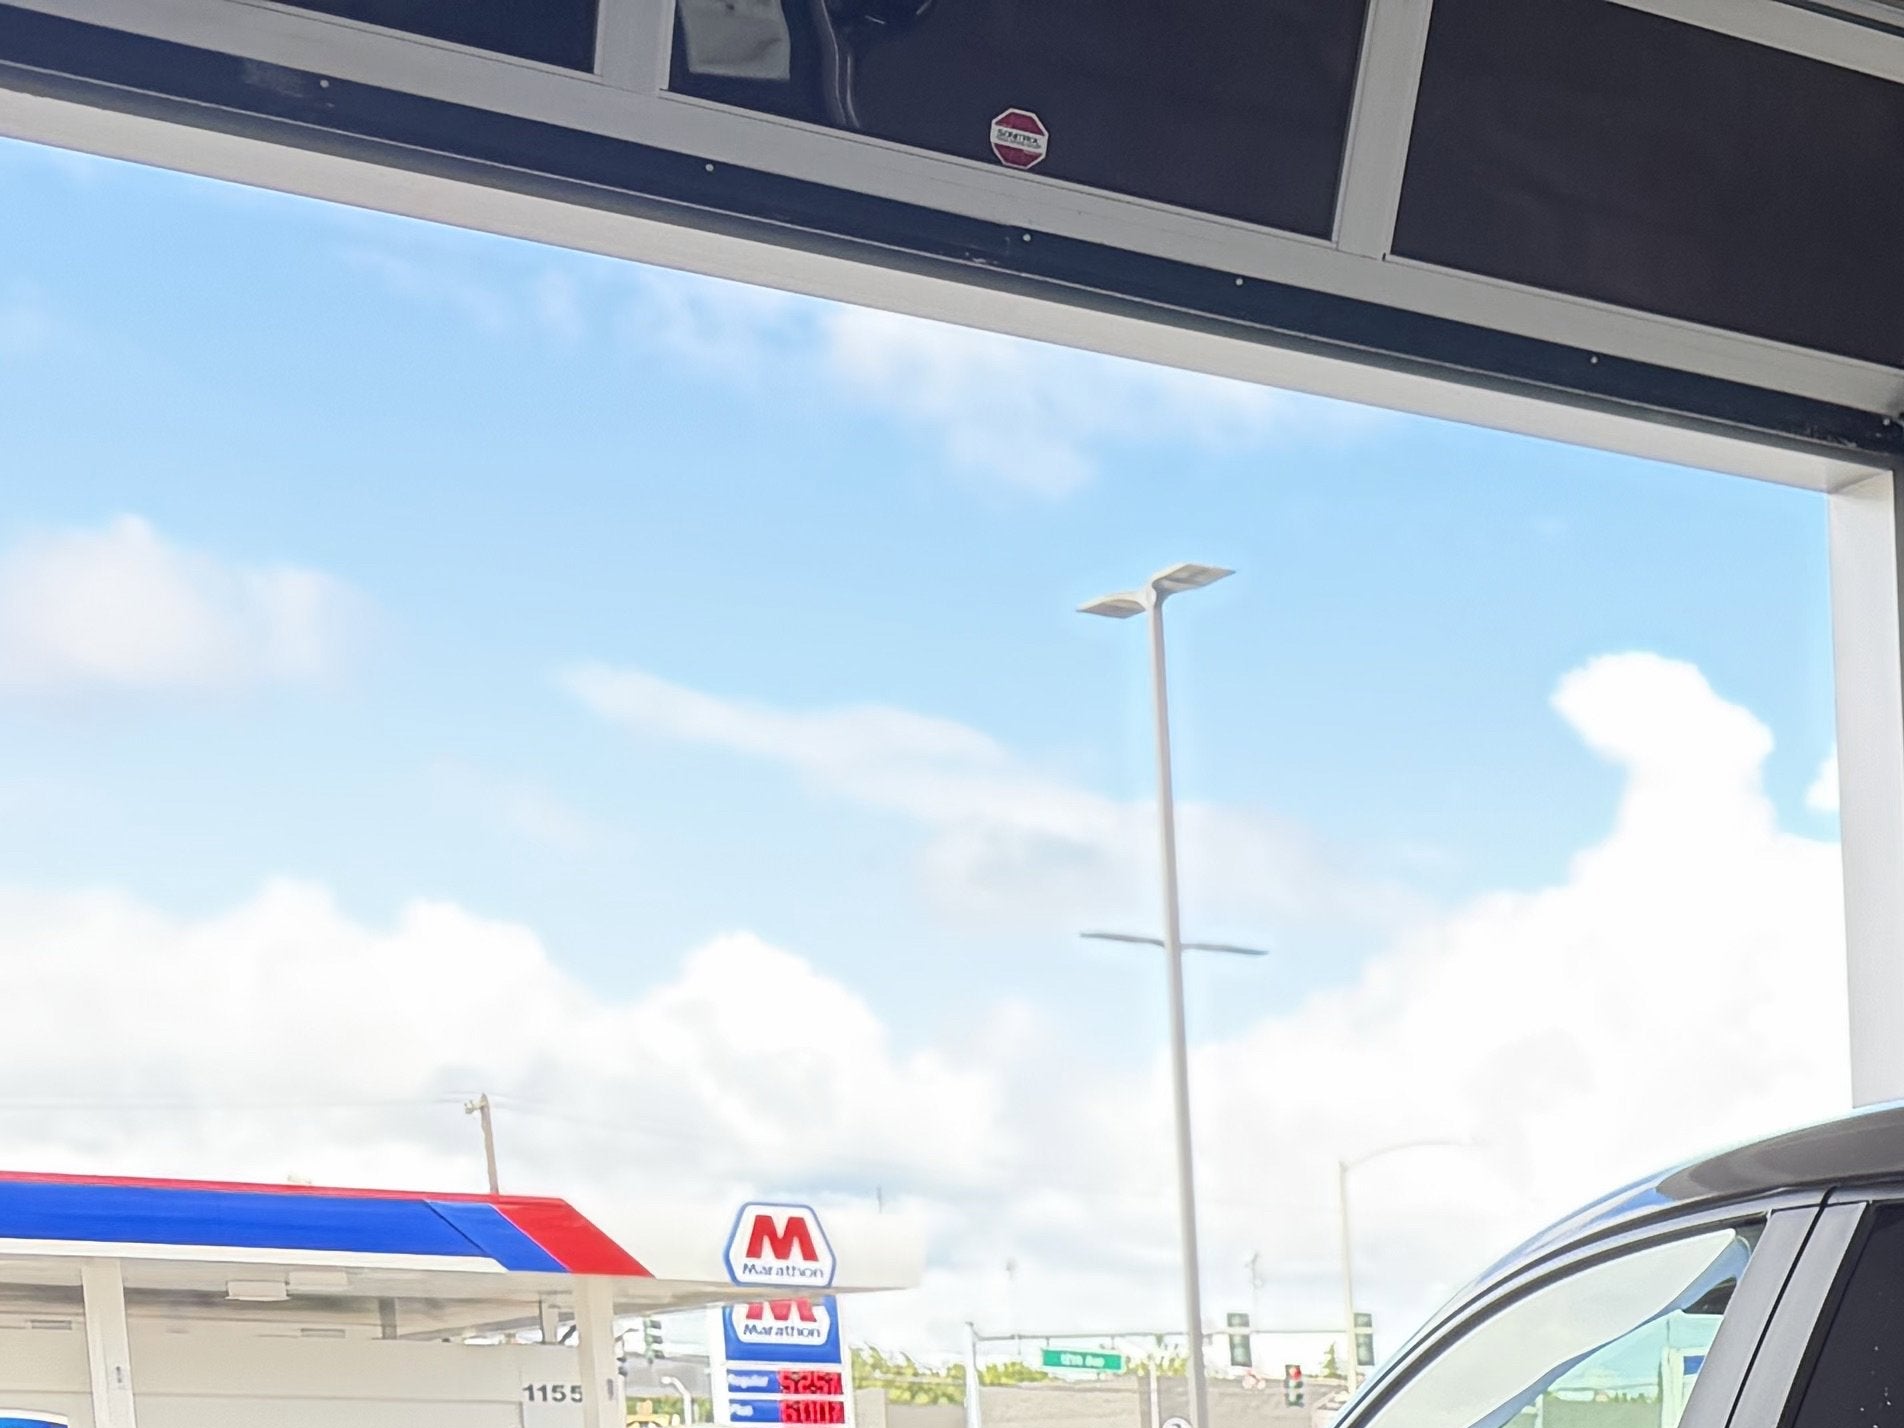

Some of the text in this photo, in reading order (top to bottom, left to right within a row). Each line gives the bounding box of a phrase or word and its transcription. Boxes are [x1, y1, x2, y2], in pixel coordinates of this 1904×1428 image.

[745, 1215, 819, 1261] M
[742, 1263, 824, 1278] Marathon
[743, 1324, 821, 1338] Marathon
[522, 1384, 583, 1403] 1155
